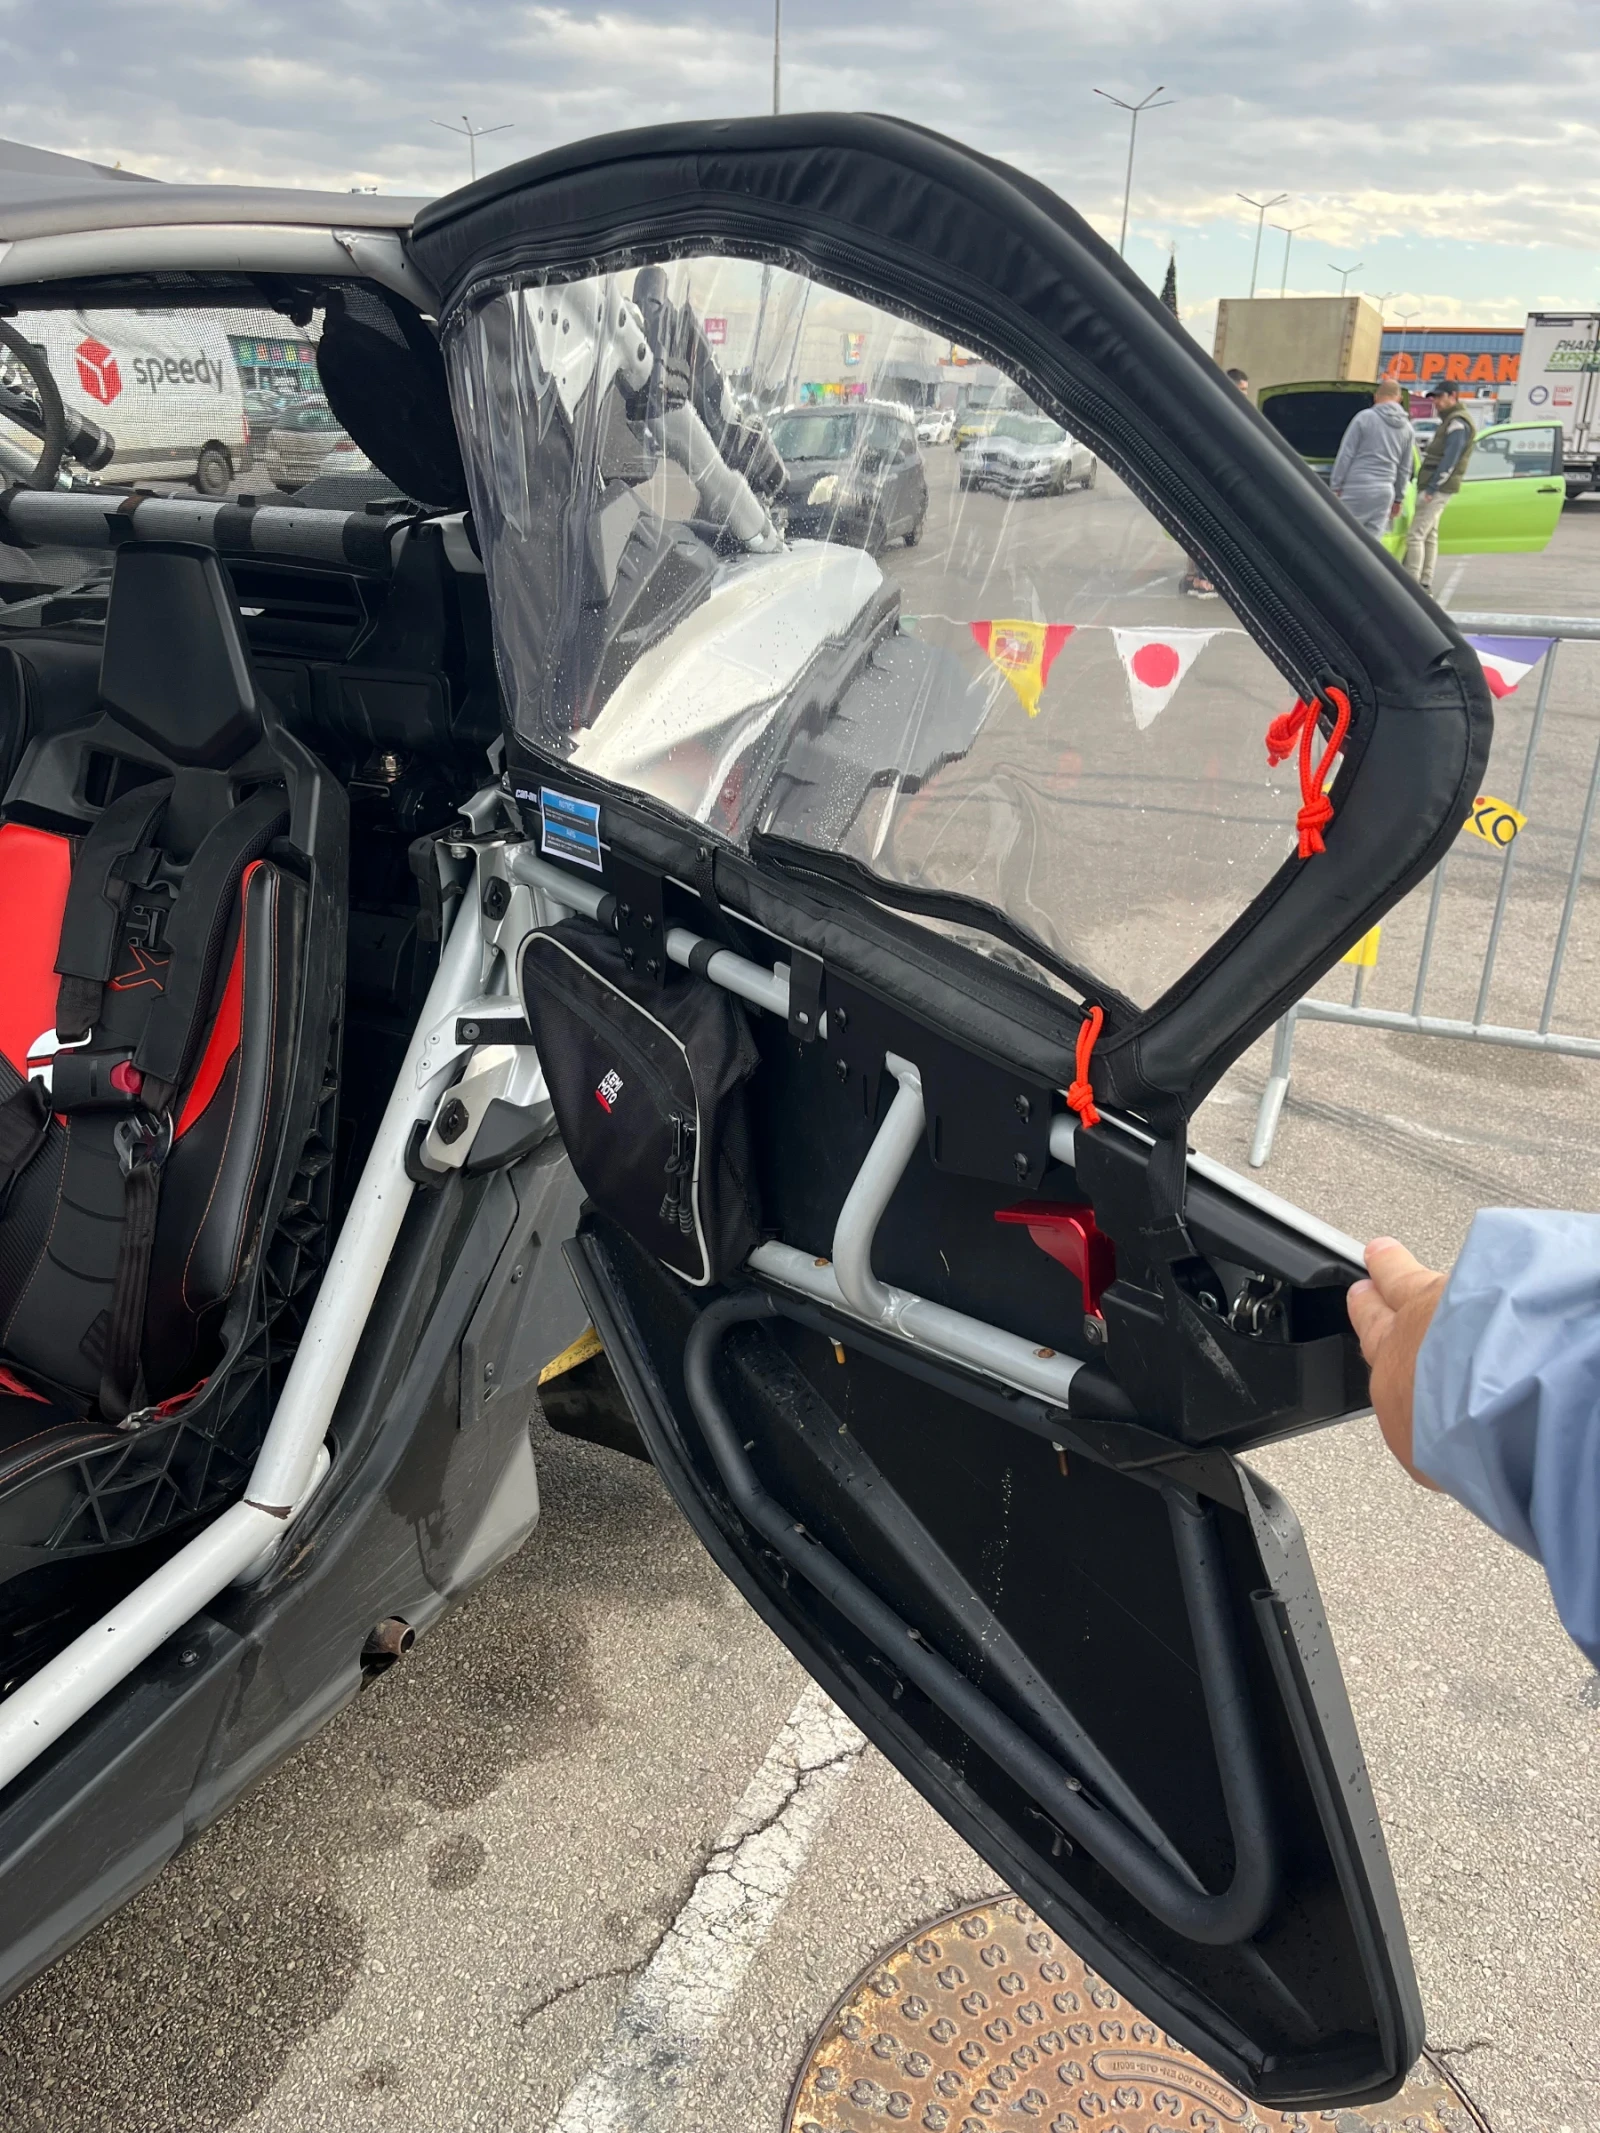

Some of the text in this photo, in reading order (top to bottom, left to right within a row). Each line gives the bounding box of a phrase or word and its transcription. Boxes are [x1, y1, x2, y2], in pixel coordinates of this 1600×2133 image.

[133, 350, 223, 393] speedy
[558, 800, 575, 812] NOTICE
[597, 1078, 618, 1105] MOTO
[604, 1068, 624, 1092] KEMI
